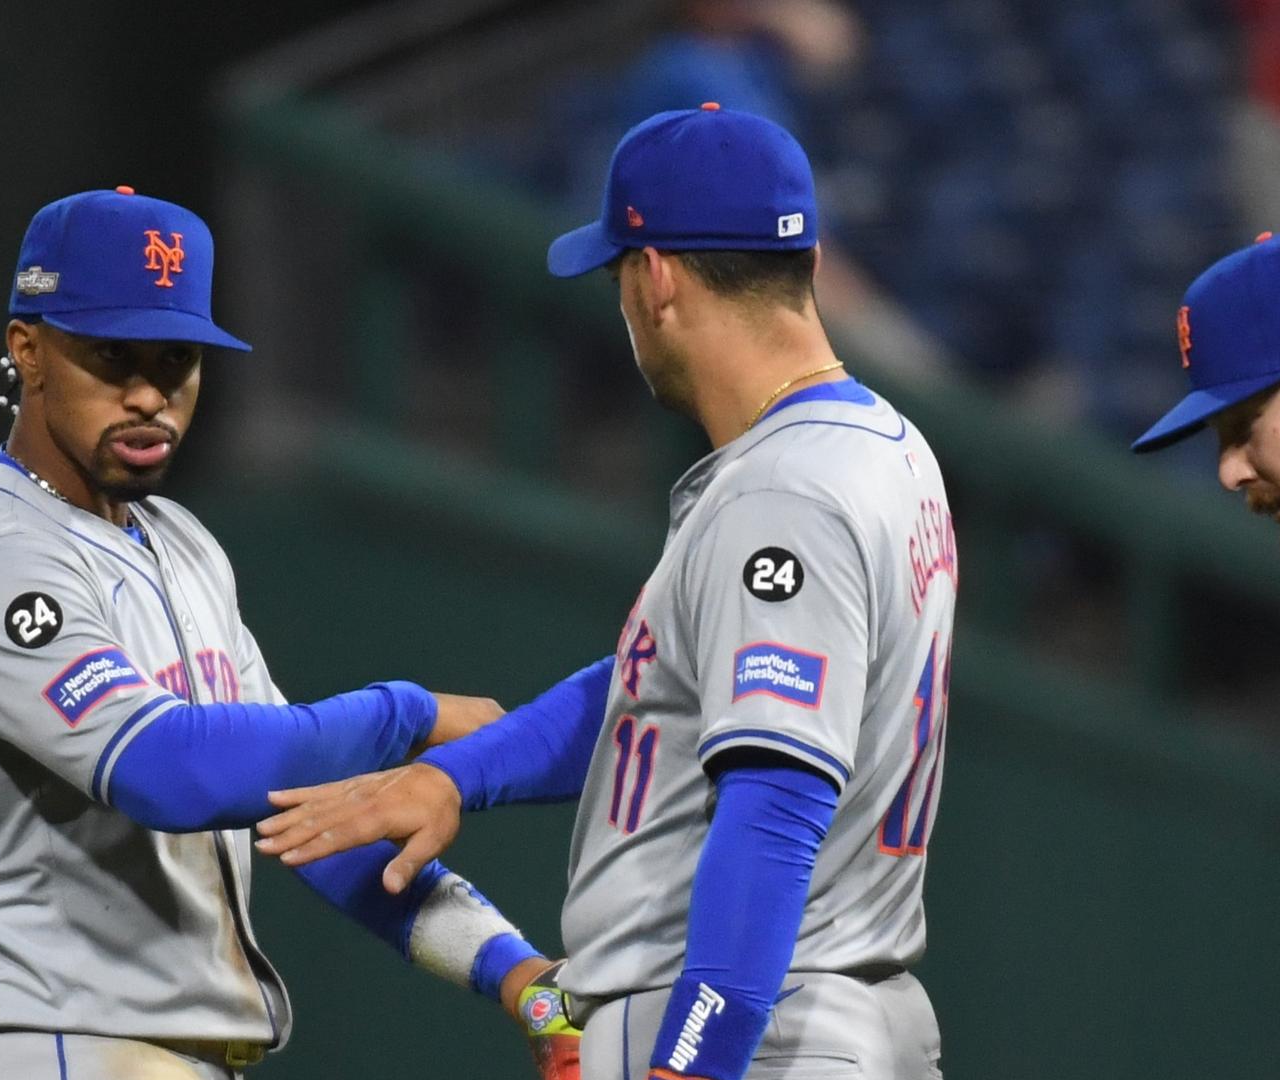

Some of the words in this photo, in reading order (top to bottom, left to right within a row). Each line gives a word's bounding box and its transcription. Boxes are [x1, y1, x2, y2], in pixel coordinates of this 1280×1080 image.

[752, 556, 796, 593] 24
[12, 596, 58, 643] 24
[744, 665, 815, 693] Presbyterian
[608, 713, 662, 835] 11
